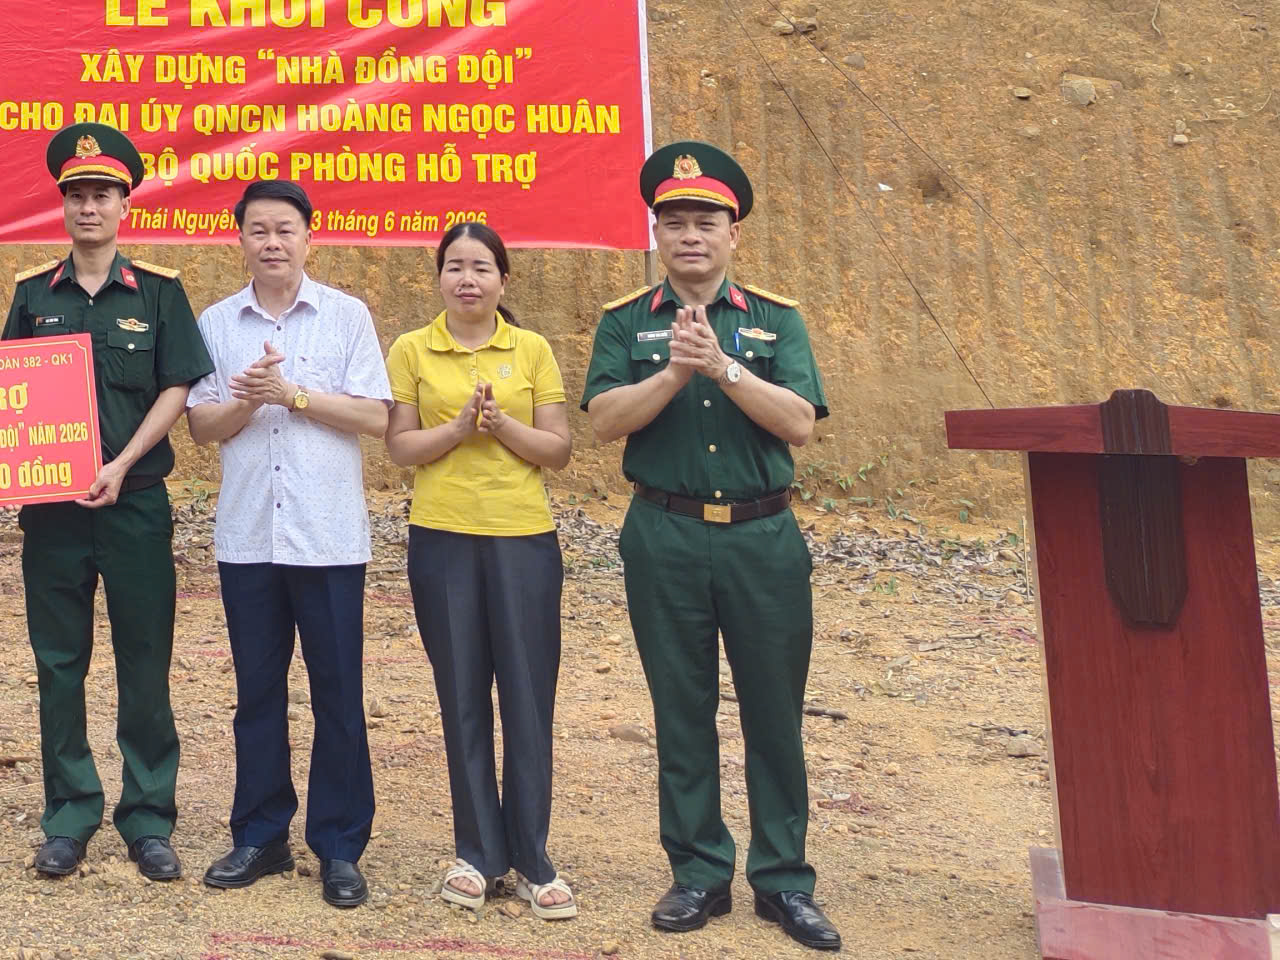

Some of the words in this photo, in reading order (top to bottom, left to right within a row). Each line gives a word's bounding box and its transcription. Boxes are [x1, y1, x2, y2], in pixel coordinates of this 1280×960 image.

[80, 48, 145, 83] XÂY
[155, 52, 246, 90] DỰNG
[257, 48, 345, 84] “NHÀ
[354, 46, 447, 84] ĐỒNG
[458, 48, 533, 90] ĐỘI”
[140, 97, 183, 132] ÚY
[194, 104, 286, 136] QNCN
[297, 98, 412, 132] HOÀNG
[423, 103, 515, 139] NGỌC
[526, 98, 620, 134] HUÂN
[141, 147, 179, 186] BỘ
[190, 142, 280, 182] QUỐC
[290, 145, 406, 182] PHÒNG
[417, 142, 462, 183] HỖ
[472, 150, 537, 189] TRỢ
[130, 208, 169, 229] Thái
[327, 209, 379, 237] tháng
[384, 210, 395, 232] 6
[400, 209, 439, 232] năm
[23, 355, 42, 369] 382
[51, 352, 73, 366] QK1
[28, 420, 57, 446] NĂM
[59, 422, 89, 444] 2026
[18, 456, 73, 488] đồng
